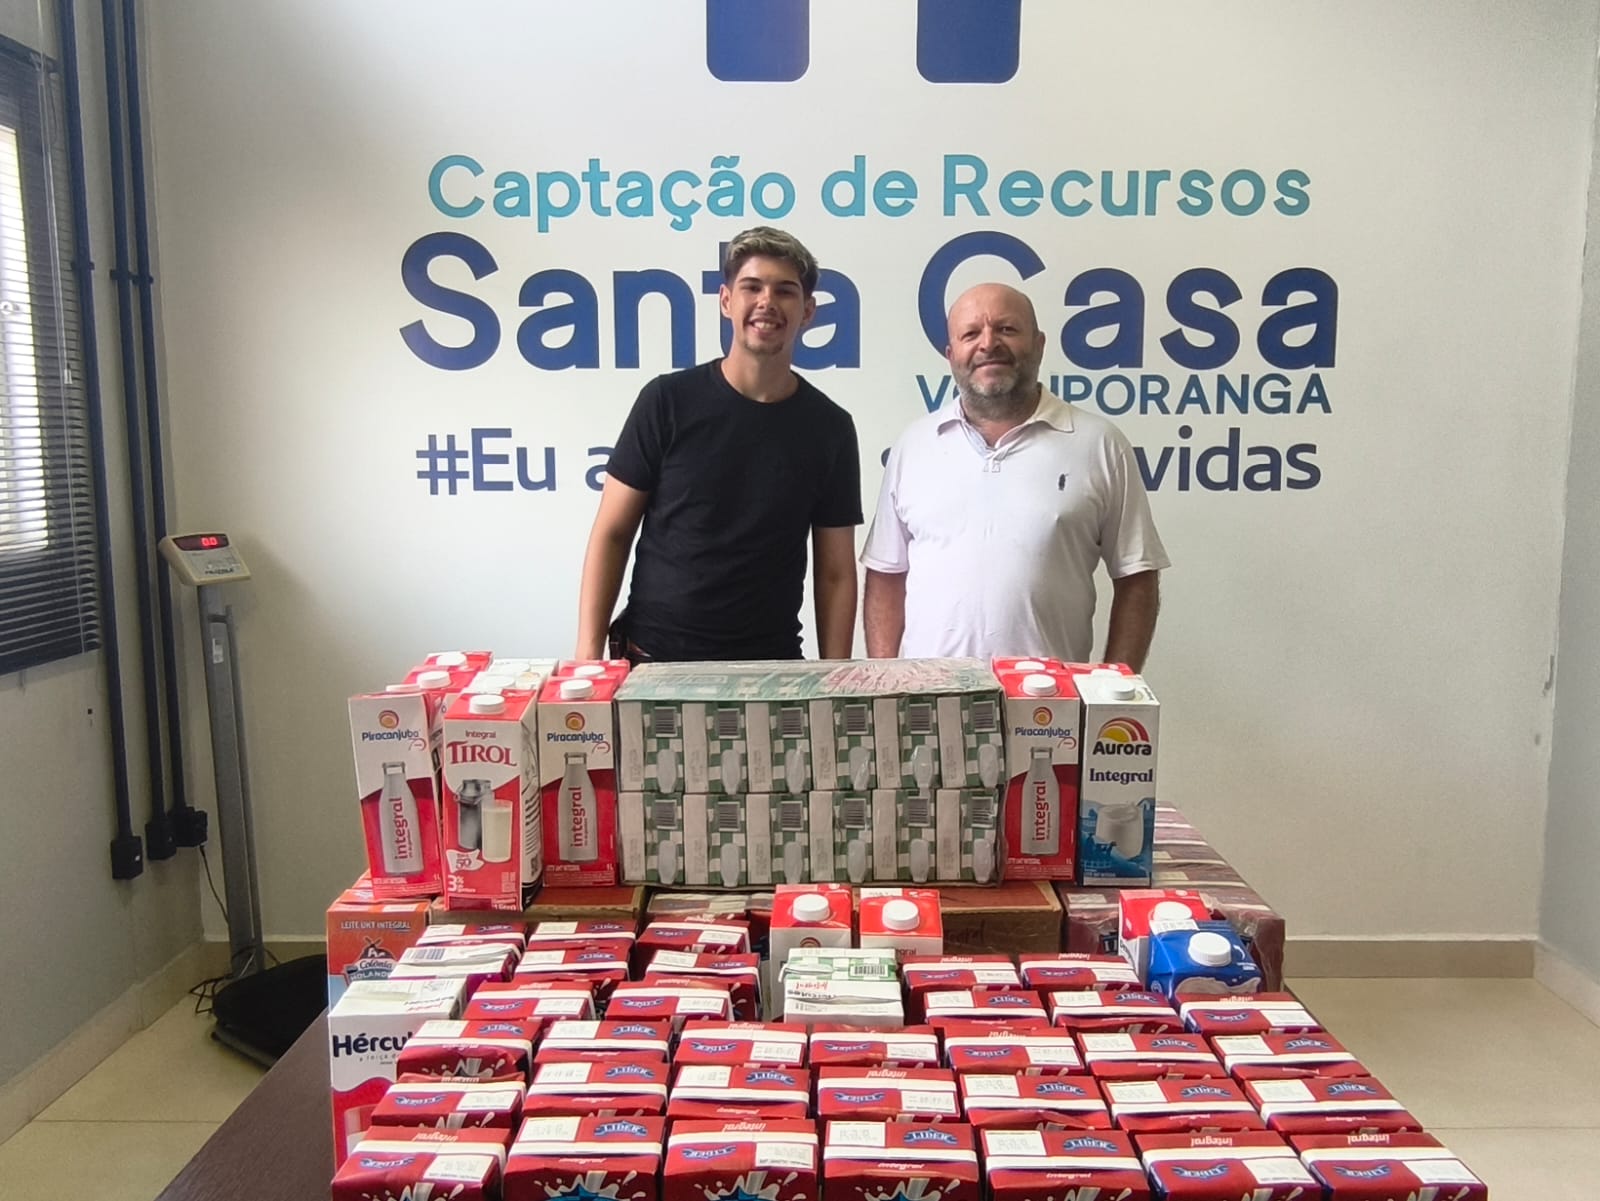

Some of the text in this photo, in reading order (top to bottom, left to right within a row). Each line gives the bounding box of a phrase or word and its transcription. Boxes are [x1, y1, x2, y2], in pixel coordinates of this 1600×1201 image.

[428, 154, 1312, 233] Captação de Recursos
[917, 230, 1340, 370] Casa
[916, 373, 1333, 415] VPORANGA
[415, 428, 557, 496] #Eu
[361, 729, 419, 742] Piracanjuba
[465, 730, 497, 739] Integral
[546, 732, 604, 743] Piracanjuba
[1014, 727, 1071, 738] Piracanjuba
[446, 740, 517, 767] TIROL
[1092, 741, 1152, 756] Aurora
[1089, 768, 1154, 785] Integral
[568, 787, 586, 847] integral
[1032, 781, 1049, 841] integral
[388, 797, 408, 860] integral
[332, 1032, 413, 1058] Hércu
